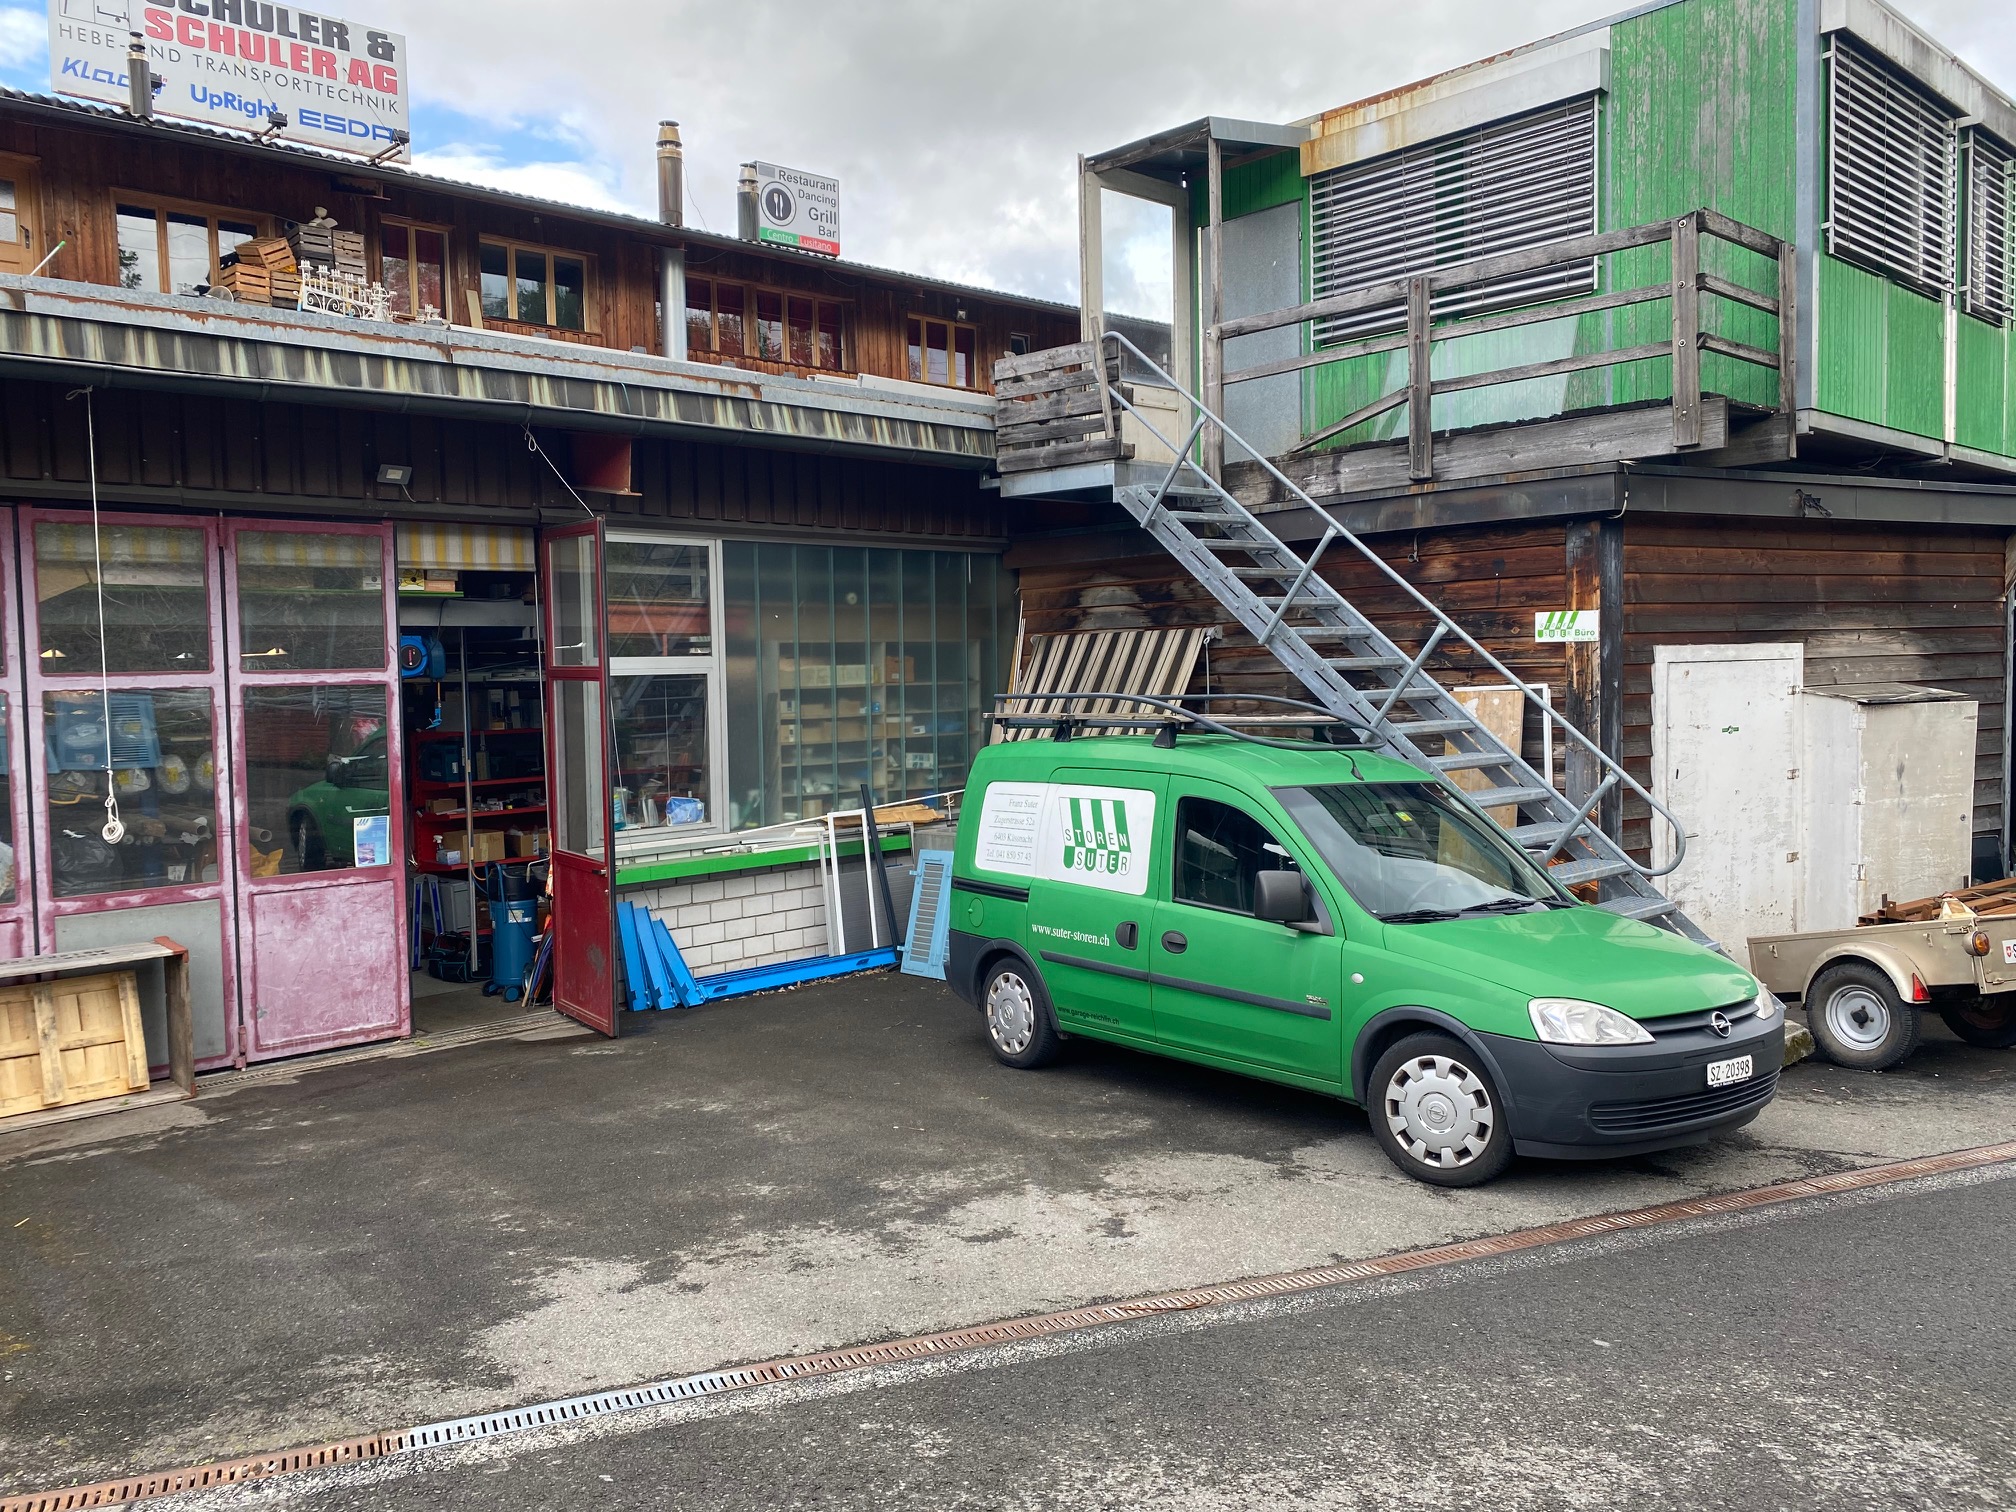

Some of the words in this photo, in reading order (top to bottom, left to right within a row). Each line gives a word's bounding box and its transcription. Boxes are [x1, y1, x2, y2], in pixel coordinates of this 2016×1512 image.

[146, 0, 350, 51] CHULER
[366, 31, 395, 62] &
[145, 8, 338, 80] SCHULER
[347, 58, 398, 95] AG
[59, 23, 126, 49] HEBE-
[193, 53, 399, 115] TRANSPORTTECHNIK
[778, 169, 837, 193] Restaurant
[798, 189, 837, 208] Dancing
[808, 206, 837, 226] Grill
[766, 229, 794, 243] Centro
[799, 235, 832, 251] Lusitano
[818, 225, 837, 238] Bar
[1574, 628, 1596, 637] Büro
[1008, 799, 1024, 808] Franz
[1024, 800, 1039, 809] Suter
[1064, 828, 1128, 847] STOREN
[1076, 851, 1128, 872] SUTER
[1031, 923, 1110, 947] www.suter-storen.ch
